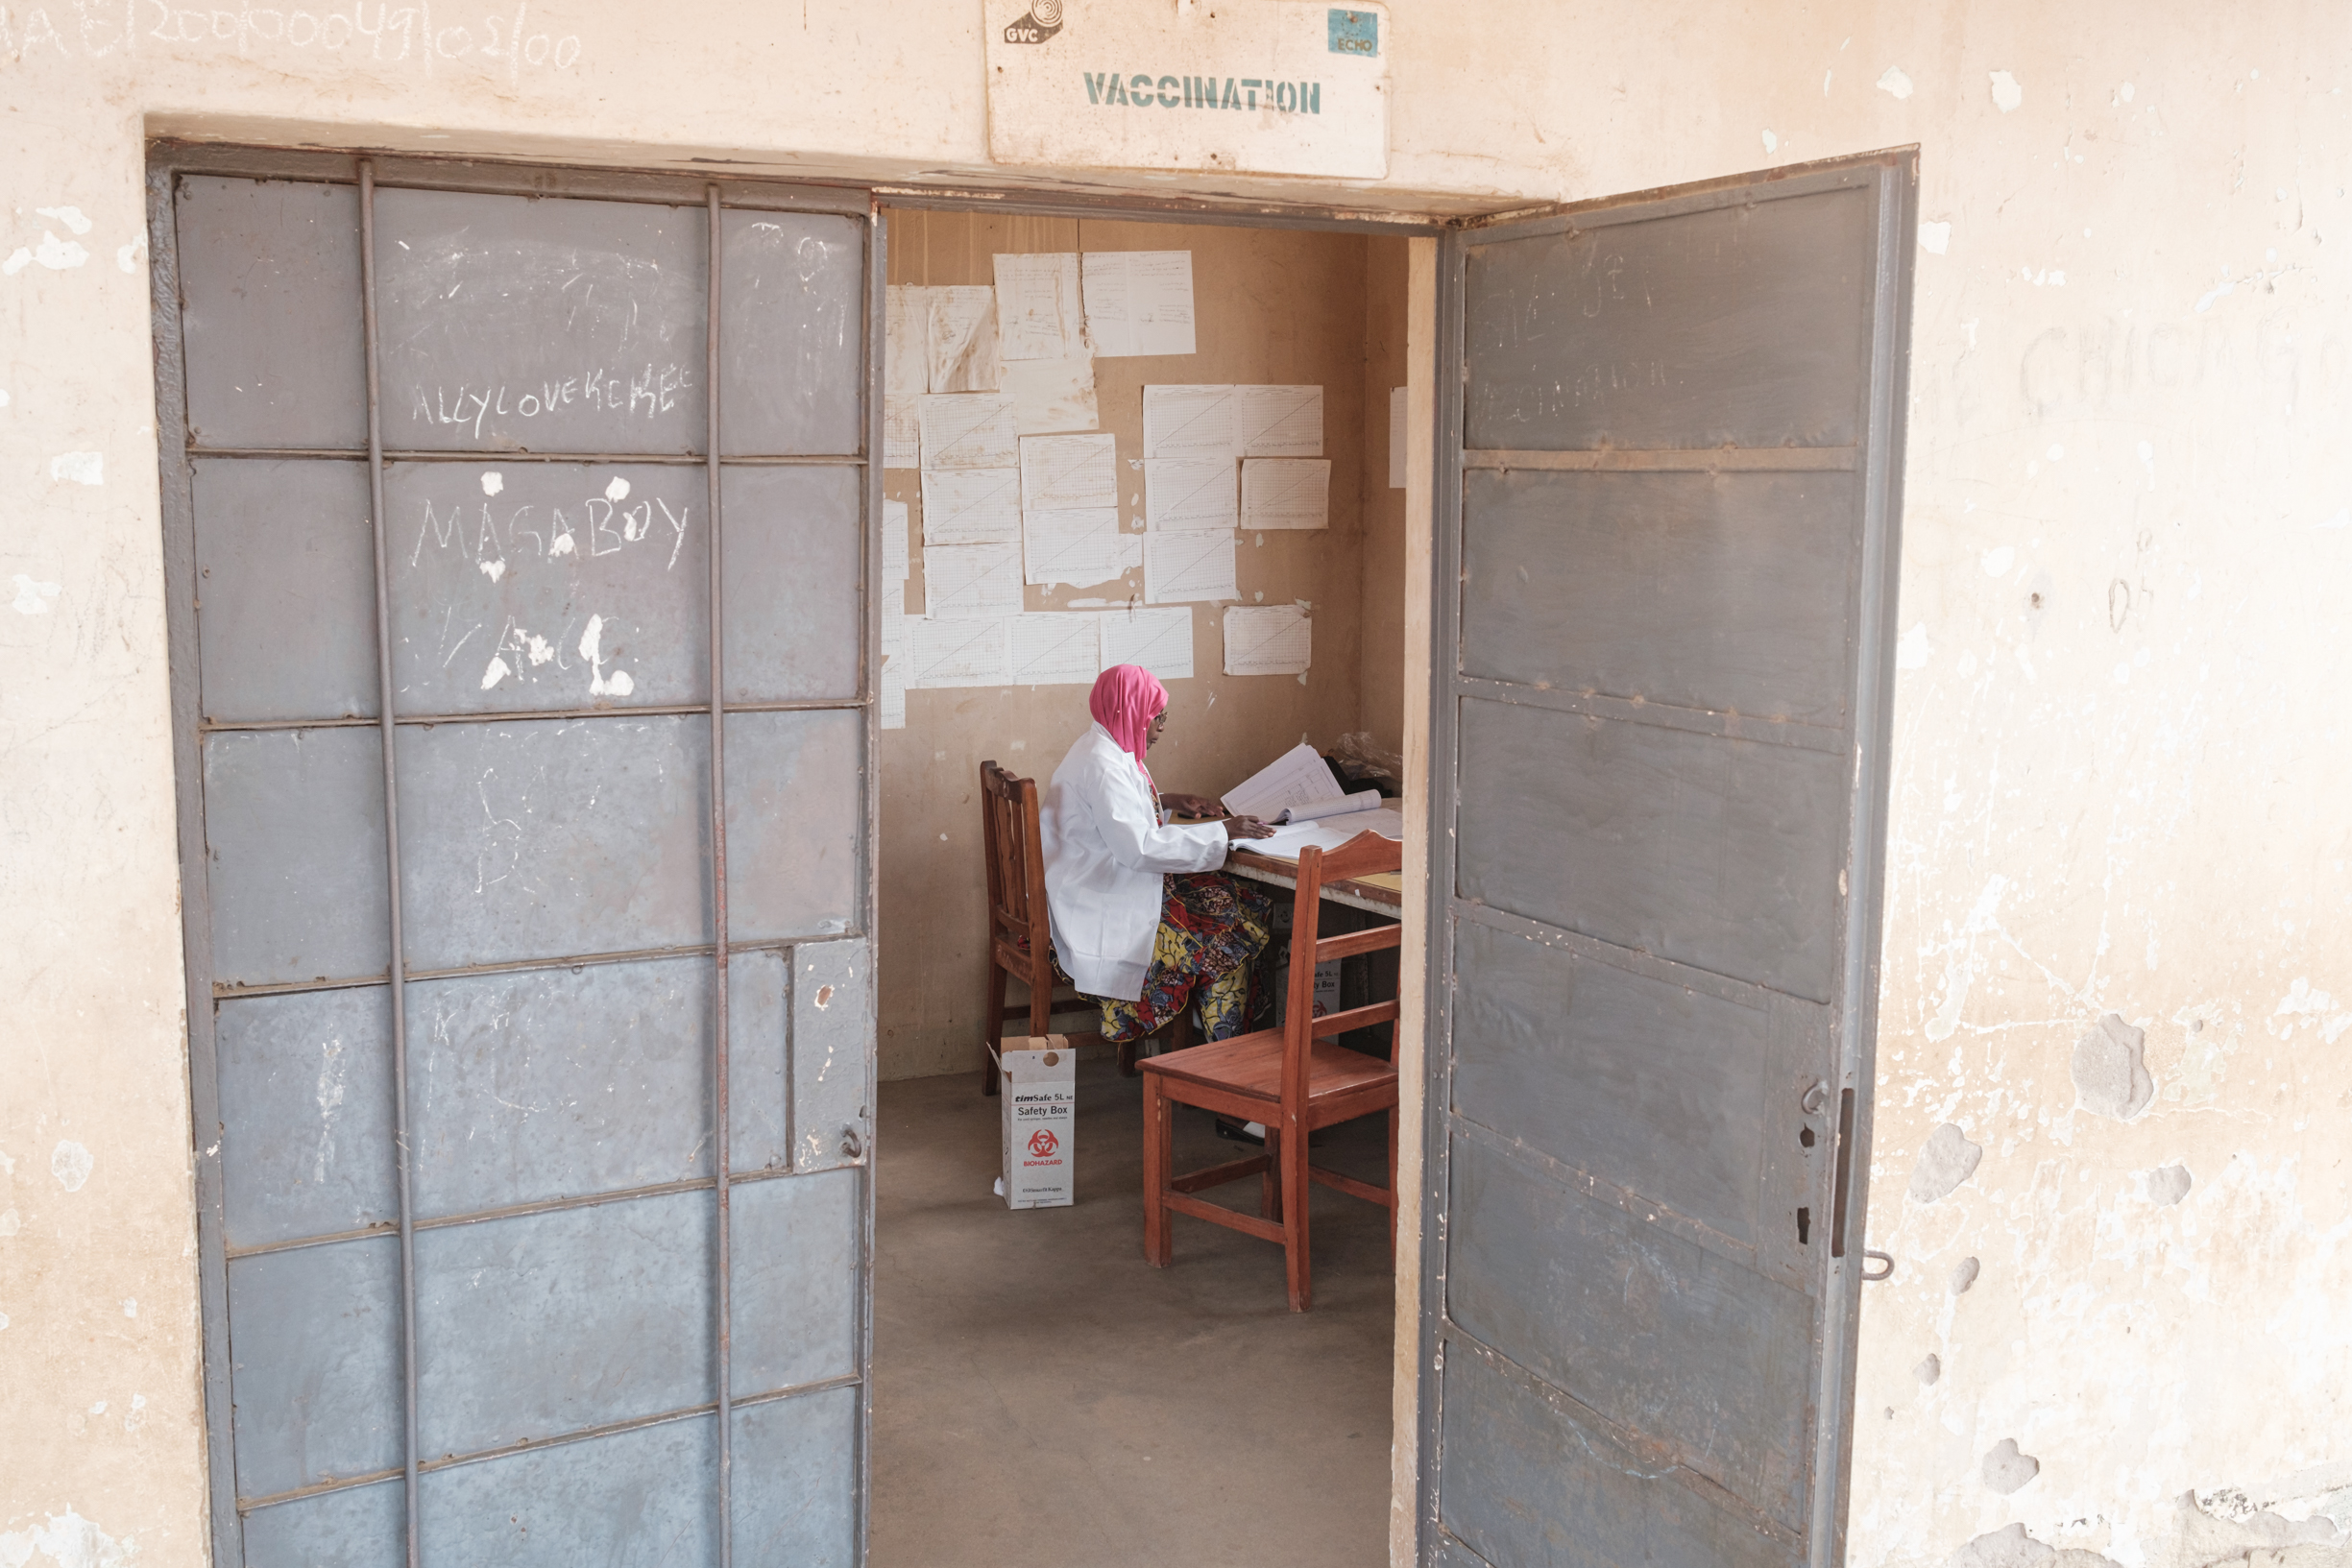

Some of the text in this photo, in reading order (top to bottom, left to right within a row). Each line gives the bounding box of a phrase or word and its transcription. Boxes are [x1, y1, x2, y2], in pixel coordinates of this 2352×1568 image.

[1006, 27, 1038, 43] GVC
[1337, 37, 1372, 52] ECHO
[1082, 71, 1321, 115] VACCINATION
[1014, 1093, 1053, 1102] timSafe
[1054, 1093, 1065, 1101] 5L
[1017, 1105, 1068, 1117] Safety Box
[1023, 1159, 1063, 1168] BIOHAZARD
